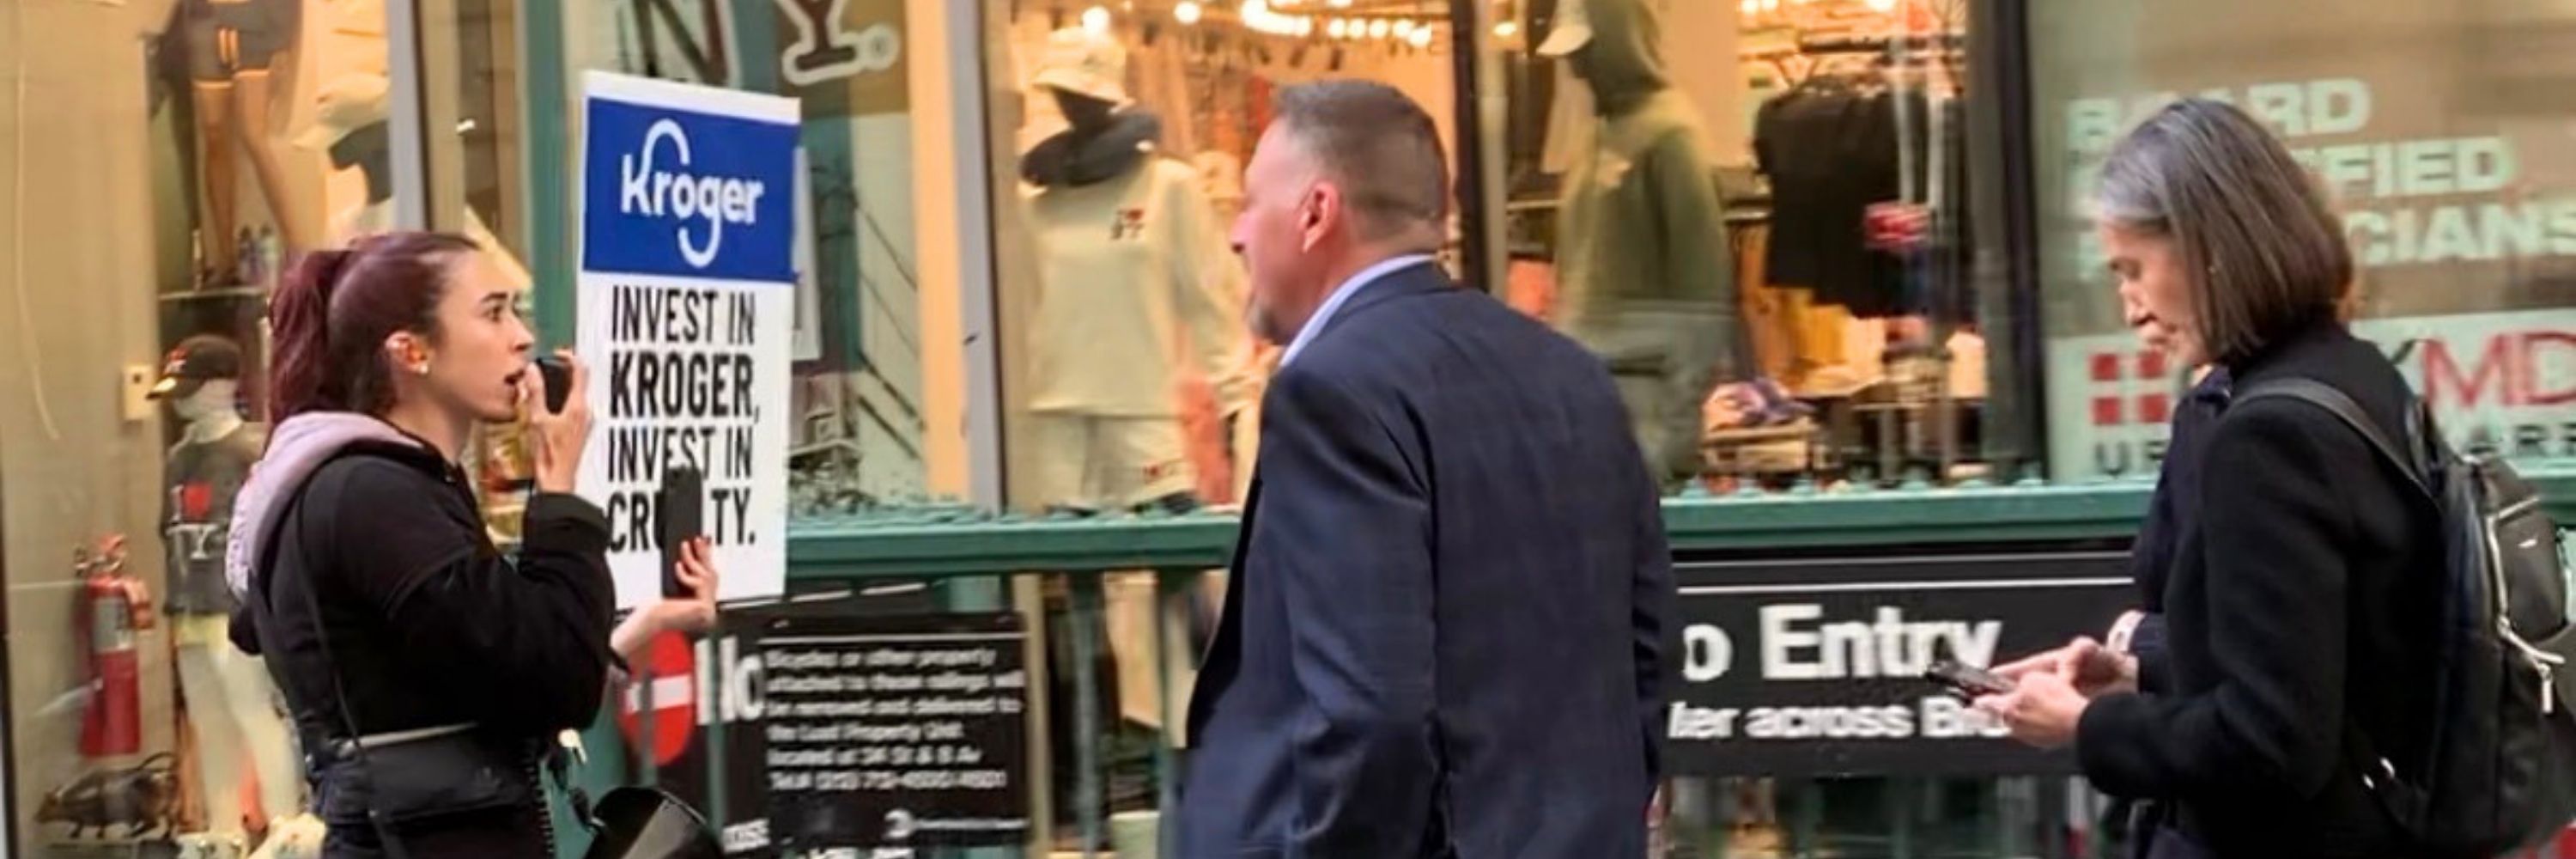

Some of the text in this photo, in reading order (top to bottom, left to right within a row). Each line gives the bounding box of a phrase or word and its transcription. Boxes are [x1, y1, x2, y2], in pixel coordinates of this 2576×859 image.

[621, 118, 764, 268] Kroger
[611, 284, 756, 345] INVEST IN
[610, 349, 761, 423] KROGER,
[607, 425, 752, 482] INVEST IN
[1759, 603, 2002, 679] Entry
[1743, 704, 1915, 739] across
